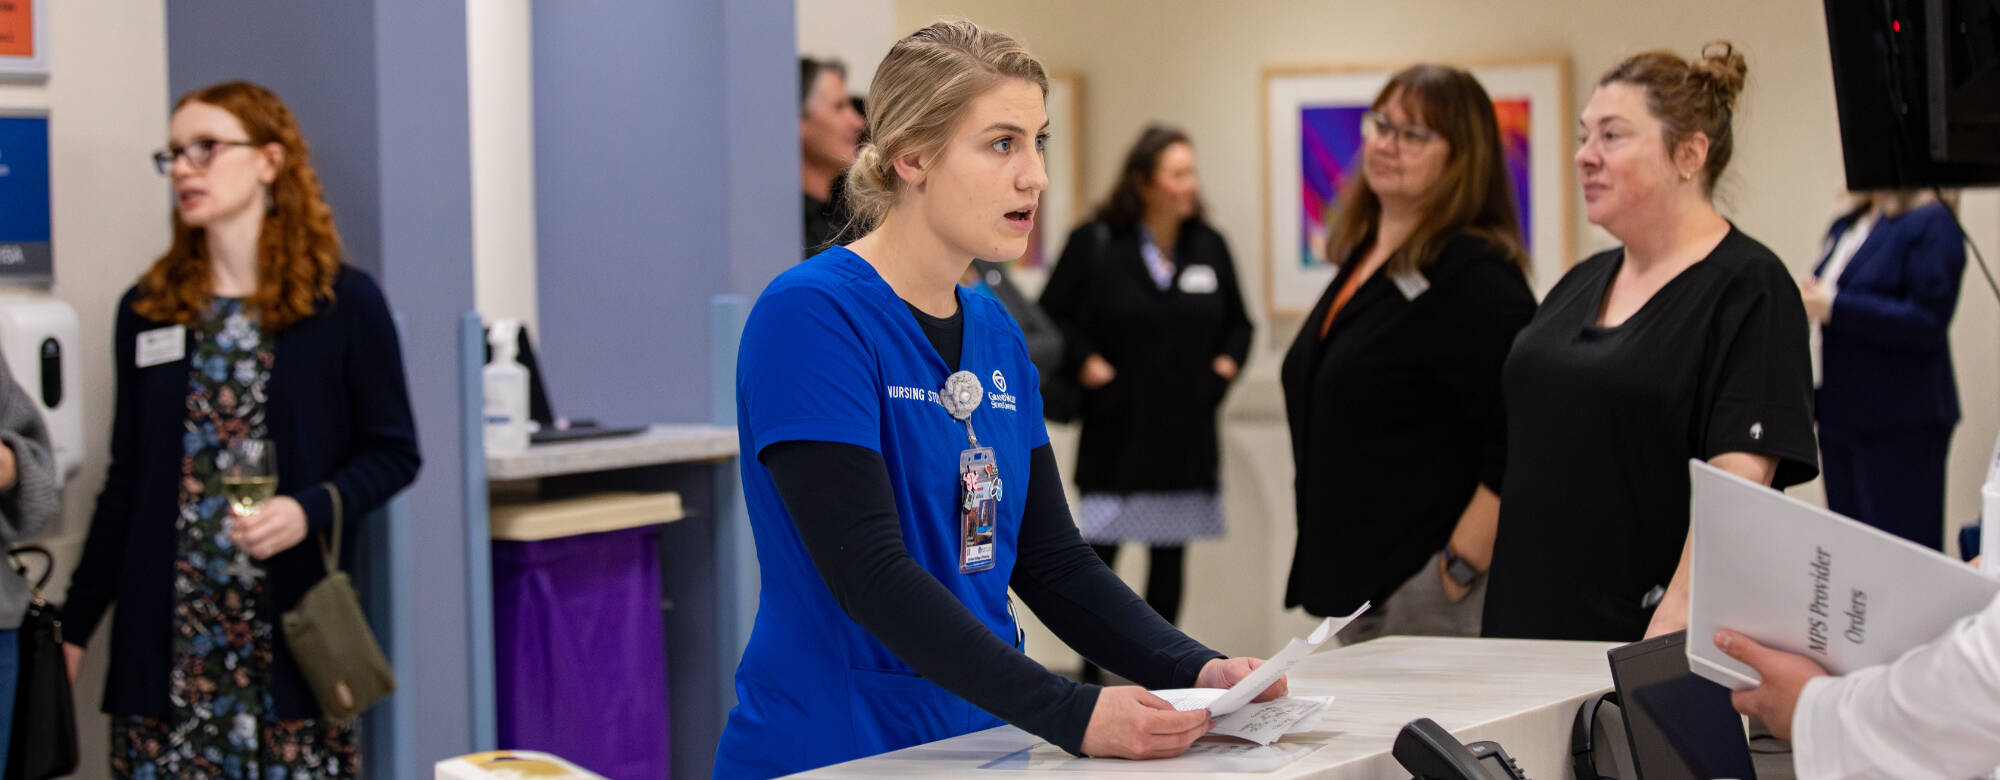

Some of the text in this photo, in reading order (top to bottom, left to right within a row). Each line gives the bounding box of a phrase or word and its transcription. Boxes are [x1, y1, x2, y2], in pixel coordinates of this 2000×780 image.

[887, 385, 925, 401] NURSING
[1808, 545, 1832, 656] MPS Provider
[1843, 588, 1868, 645] Orders
